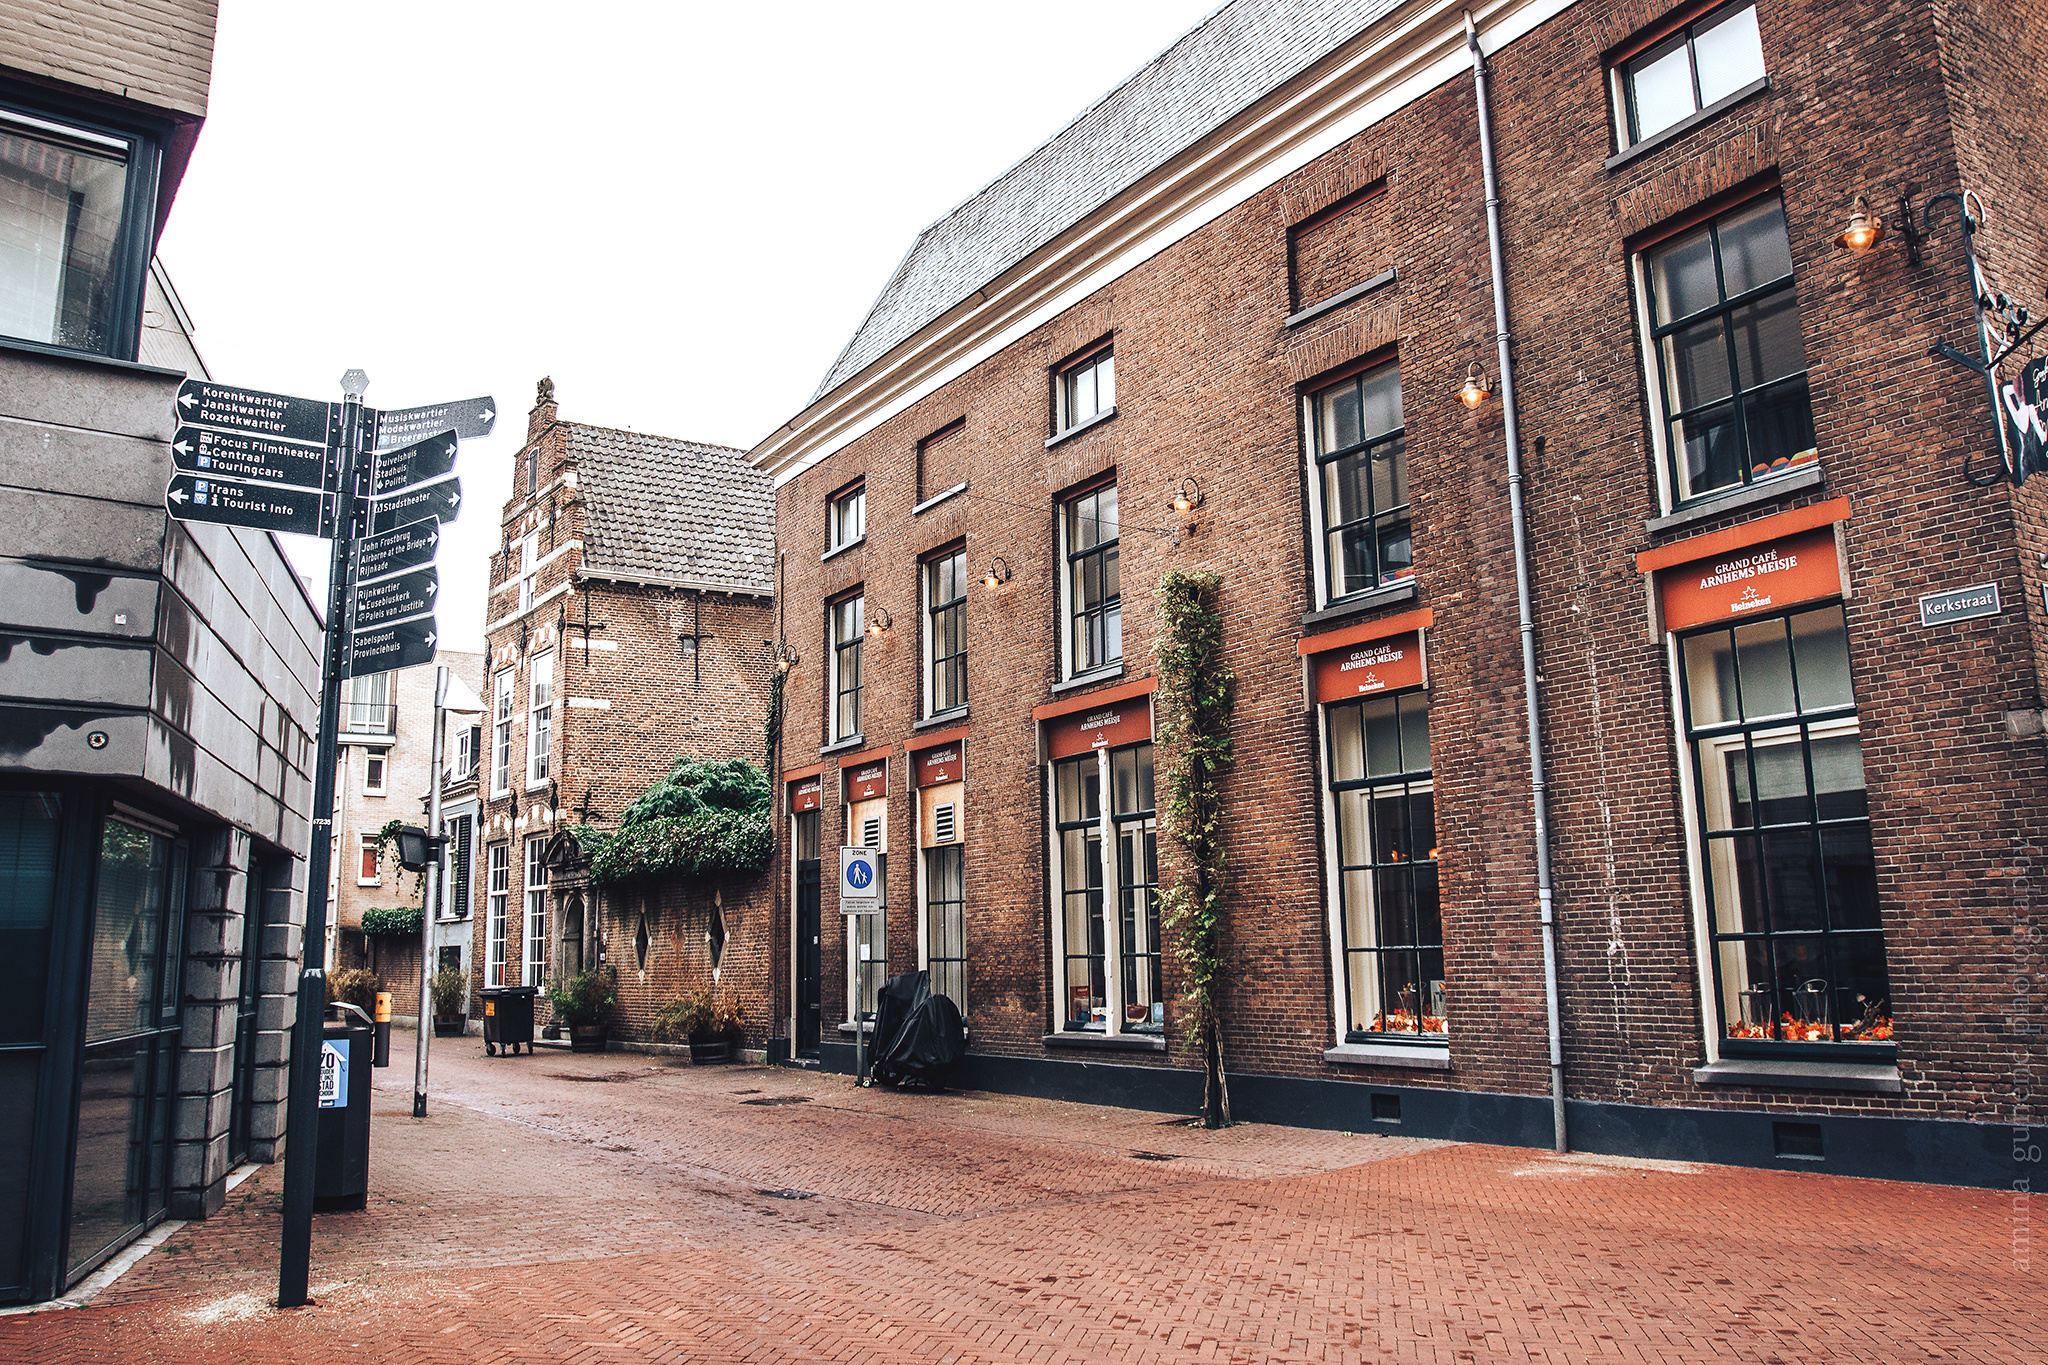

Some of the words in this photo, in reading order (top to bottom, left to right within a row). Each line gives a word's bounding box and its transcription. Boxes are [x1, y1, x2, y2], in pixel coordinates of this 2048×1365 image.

[202, 386, 289, 410] Korenkwartier
[202, 399, 282, 420] Janskwartier
[380, 409, 448, 423] Musiskwartier
[201, 410, 286, 432] Rozetkwartier
[379, 420, 444, 434] Modekwartier
[212, 447, 265, 464] Centraal
[214, 436, 248, 450] Focus
[252, 441, 321, 461] Filmtheater
[375, 450, 417, 468] Duivelshuis
[212, 459, 284, 479] Touringcars
[375, 464, 407, 479] Stadhuis
[209, 483, 244, 497] Trans
[385, 475, 406, 488] Politie
[223, 497, 266, 512] Tourist
[270, 503, 294, 516] Info
[384, 493, 430, 511] Stadstheater
[362, 542, 379, 552] John
[380, 532, 410, 547] Frostbrug
[361, 551, 387, 564] Airborne
[388, 548, 394, 556] at
[395, 545, 406, 555] the
[407, 539, 426, 550] Bridge
[360, 562, 388, 576] Rijnkade
[1715, 558, 1750, 575] GRAND
[1751, 549, 1778, 564] CAFÉ
[1699, 566, 1755, 589] ARNHEMS
[1757, 556, 1798, 576] MEISJE
[358, 583, 400, 600] Rijnkwartier
[366, 591, 410, 609] Eusebiuskerk
[365, 610, 385, 621] Paleis
[386, 607, 397, 616] van
[399, 599, 424, 613] Justitie
[1730, 595, 1772, 612] Heineken
[1926, 594, 1993, 615] Kerkstraat
[354, 631, 394, 647] Sabelspoort
[354, 642, 400, 659] Provinciehuis
[1350, 650, 1373, 661] GRAND
[1374, 644, 1391, 655] CAFÉ
[1340, 657, 1376, 671] ARNHEMS
[1377, 650, 1404, 664] MEISJE
